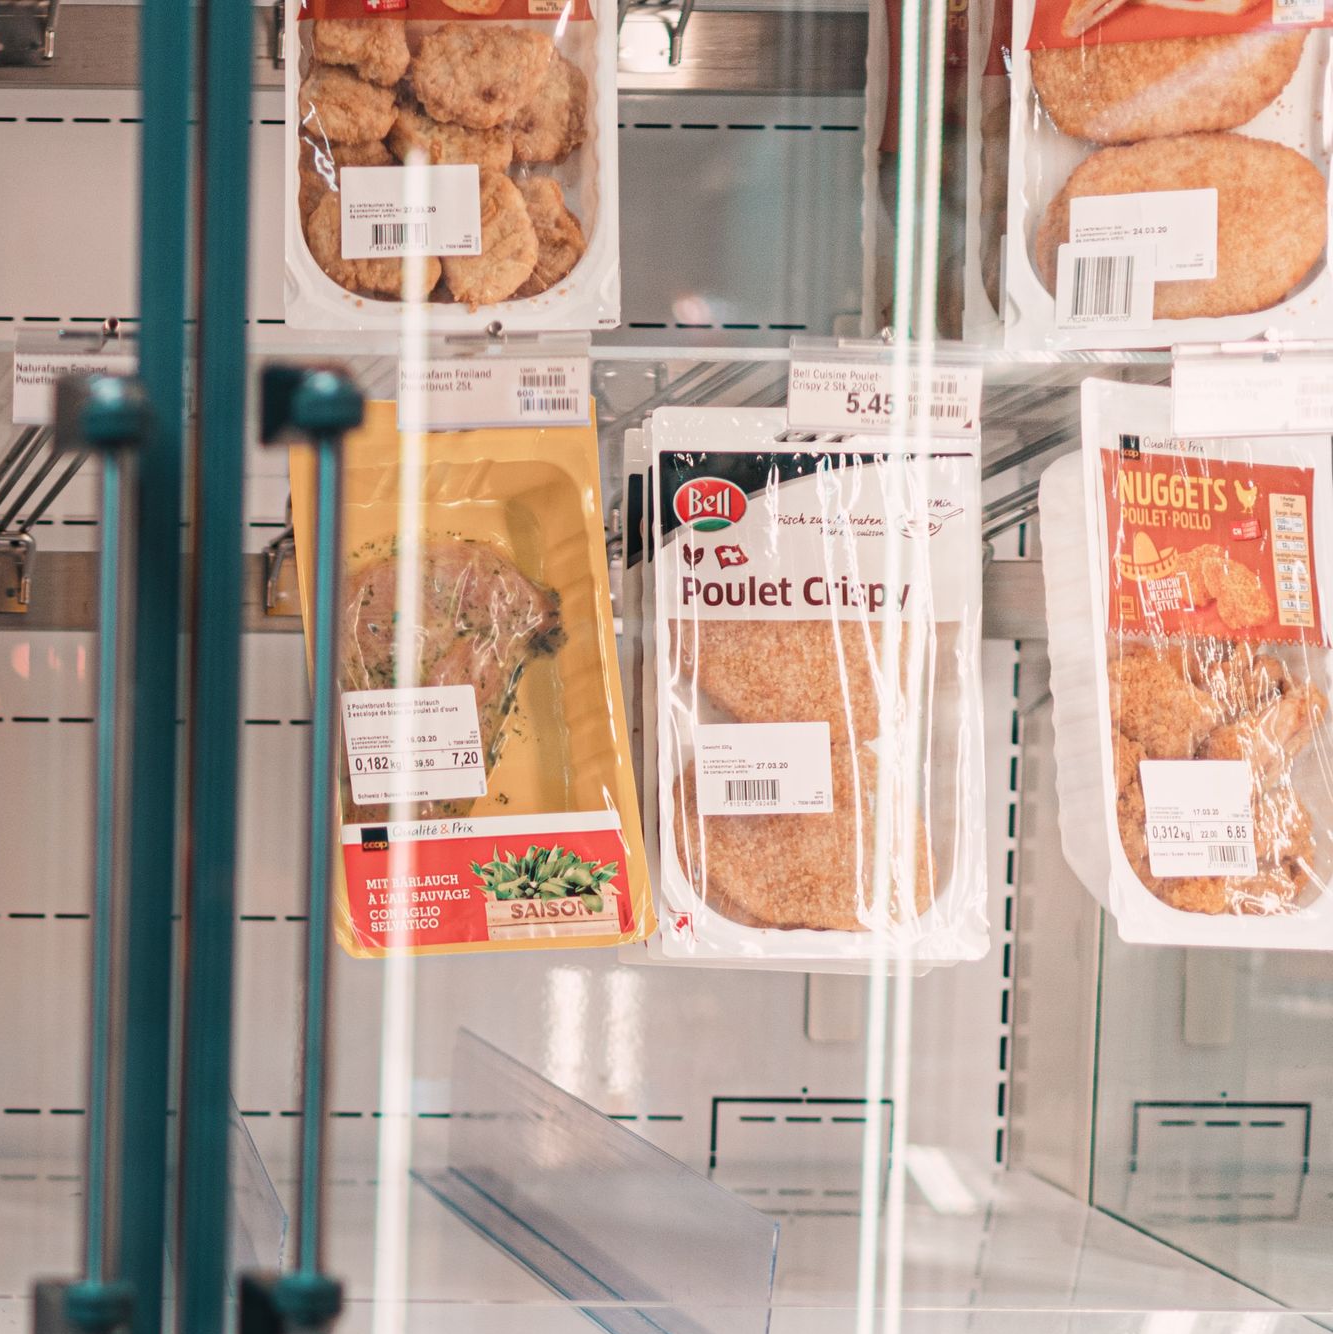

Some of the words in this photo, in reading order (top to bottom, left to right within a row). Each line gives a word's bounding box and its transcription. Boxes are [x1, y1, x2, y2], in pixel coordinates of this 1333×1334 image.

[455, 369, 492, 379] Freiland
[793, 368, 810, 379] Bell
[813, 370, 846, 380] Cuisine
[849, 371, 882, 381] Poulet-
[793, 381, 822, 393] Crispy
[825, 382, 830, 390] 2
[851, 382, 876, 393] 220G
[846, 393, 896, 415] 5.45
[1118, 470, 1227, 512] NUGGETS
[689, 487, 730, 518] Bell
[682, 575, 792, 606] Poulet
[803, 575, 910, 612] Crispy
[1150, 588, 1183, 601] MEXICAN
[1156, 600, 1180, 612] STYLE
[355, 756, 389, 772] 0,182
[414, 759, 434, 768] 39,50
[452, 751, 478, 766] 7,20
[440, 823, 449, 834] &
[451, 822, 474, 834] Prix
[1152, 825, 1180, 840] 0,312
[1181, 829, 1191, 840] kg
[1226, 825, 1247, 839] 6,85
[366, 878, 389, 890] MIT
[412, 888, 471, 901] SAUVAGE
[370, 908, 398, 920] CON
[511, 900, 593, 919] SAISON
[371, 918, 439, 933] SELVATICO
